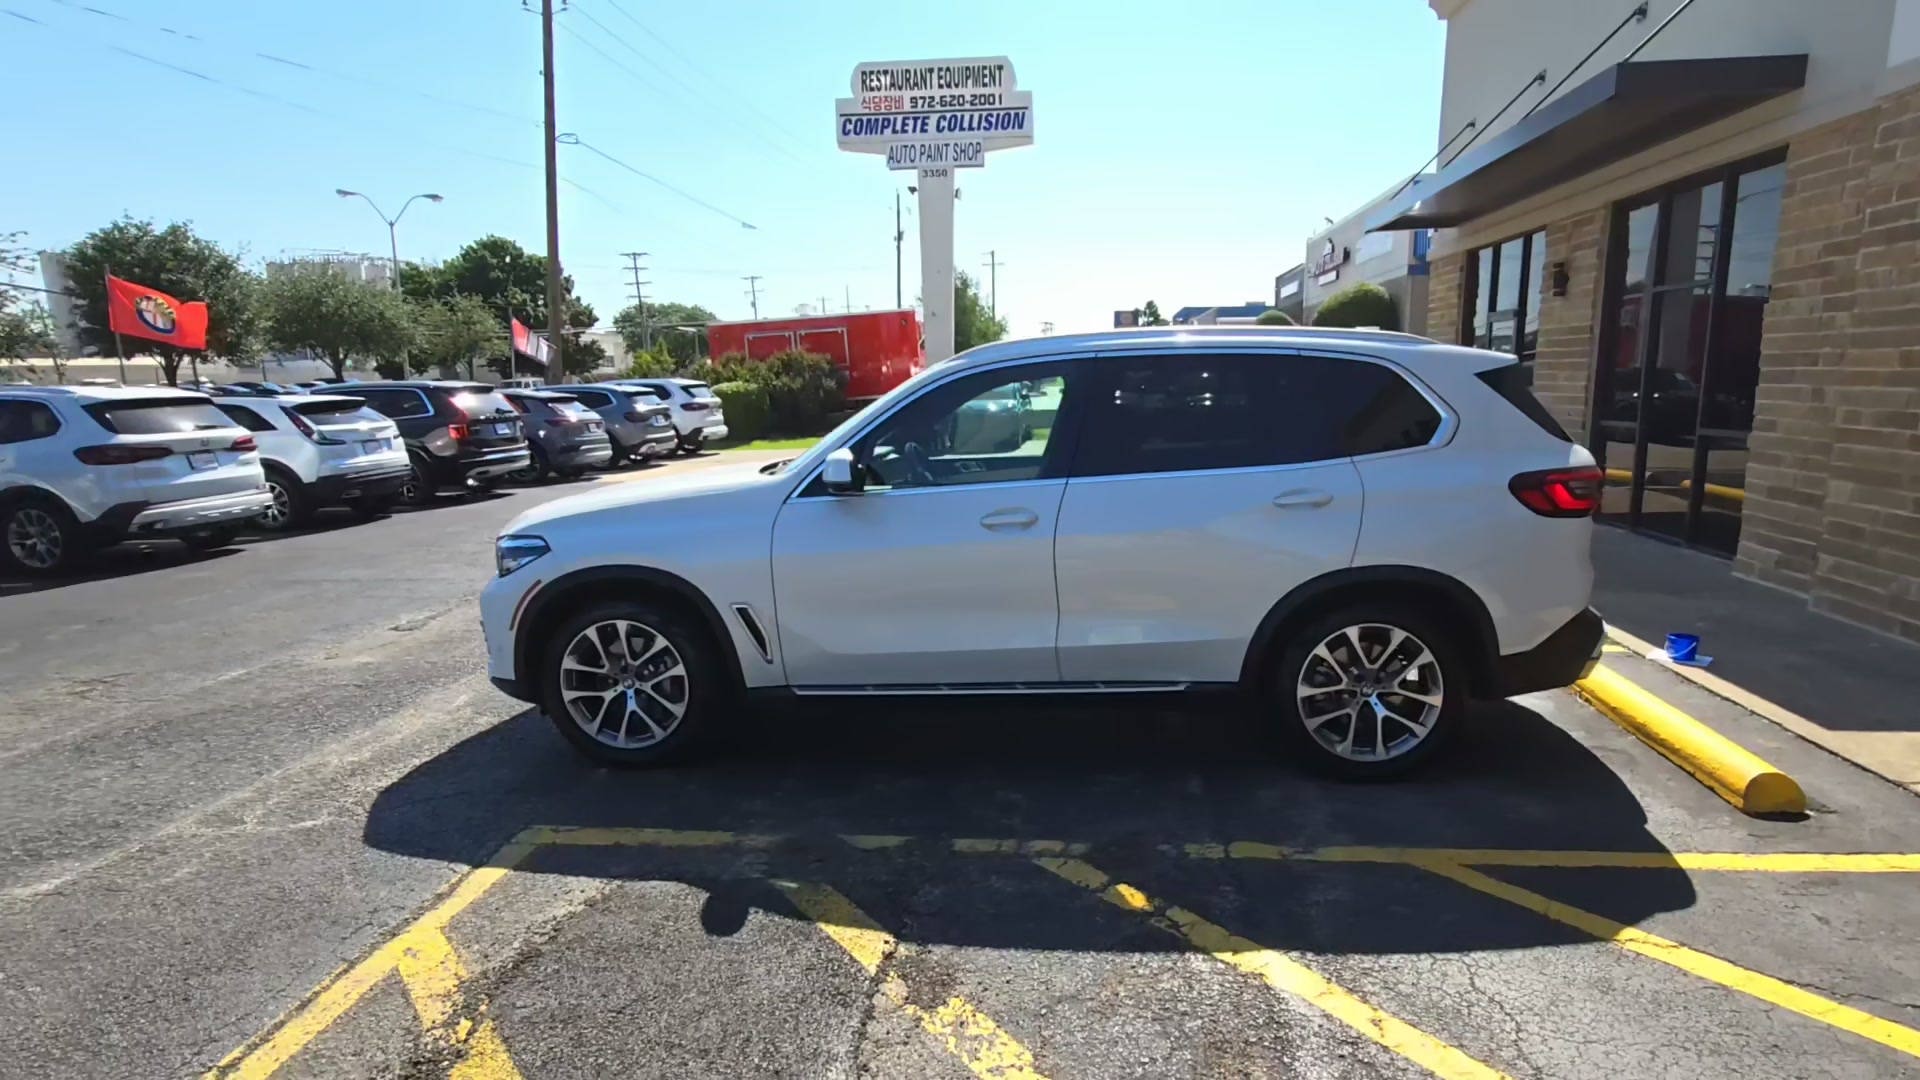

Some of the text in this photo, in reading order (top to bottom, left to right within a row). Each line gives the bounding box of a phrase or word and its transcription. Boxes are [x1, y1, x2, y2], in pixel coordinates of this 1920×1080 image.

[861, 65, 1004, 92] RESTAURANT EQUIPMENT
[861, 95, 904, 111] 식당장비
[842, 112, 1026, 136] COMPLETE COLLISION
[888, 142, 982, 164] AUTO PAINT SHOP
[922, 169, 948, 178] 3350
